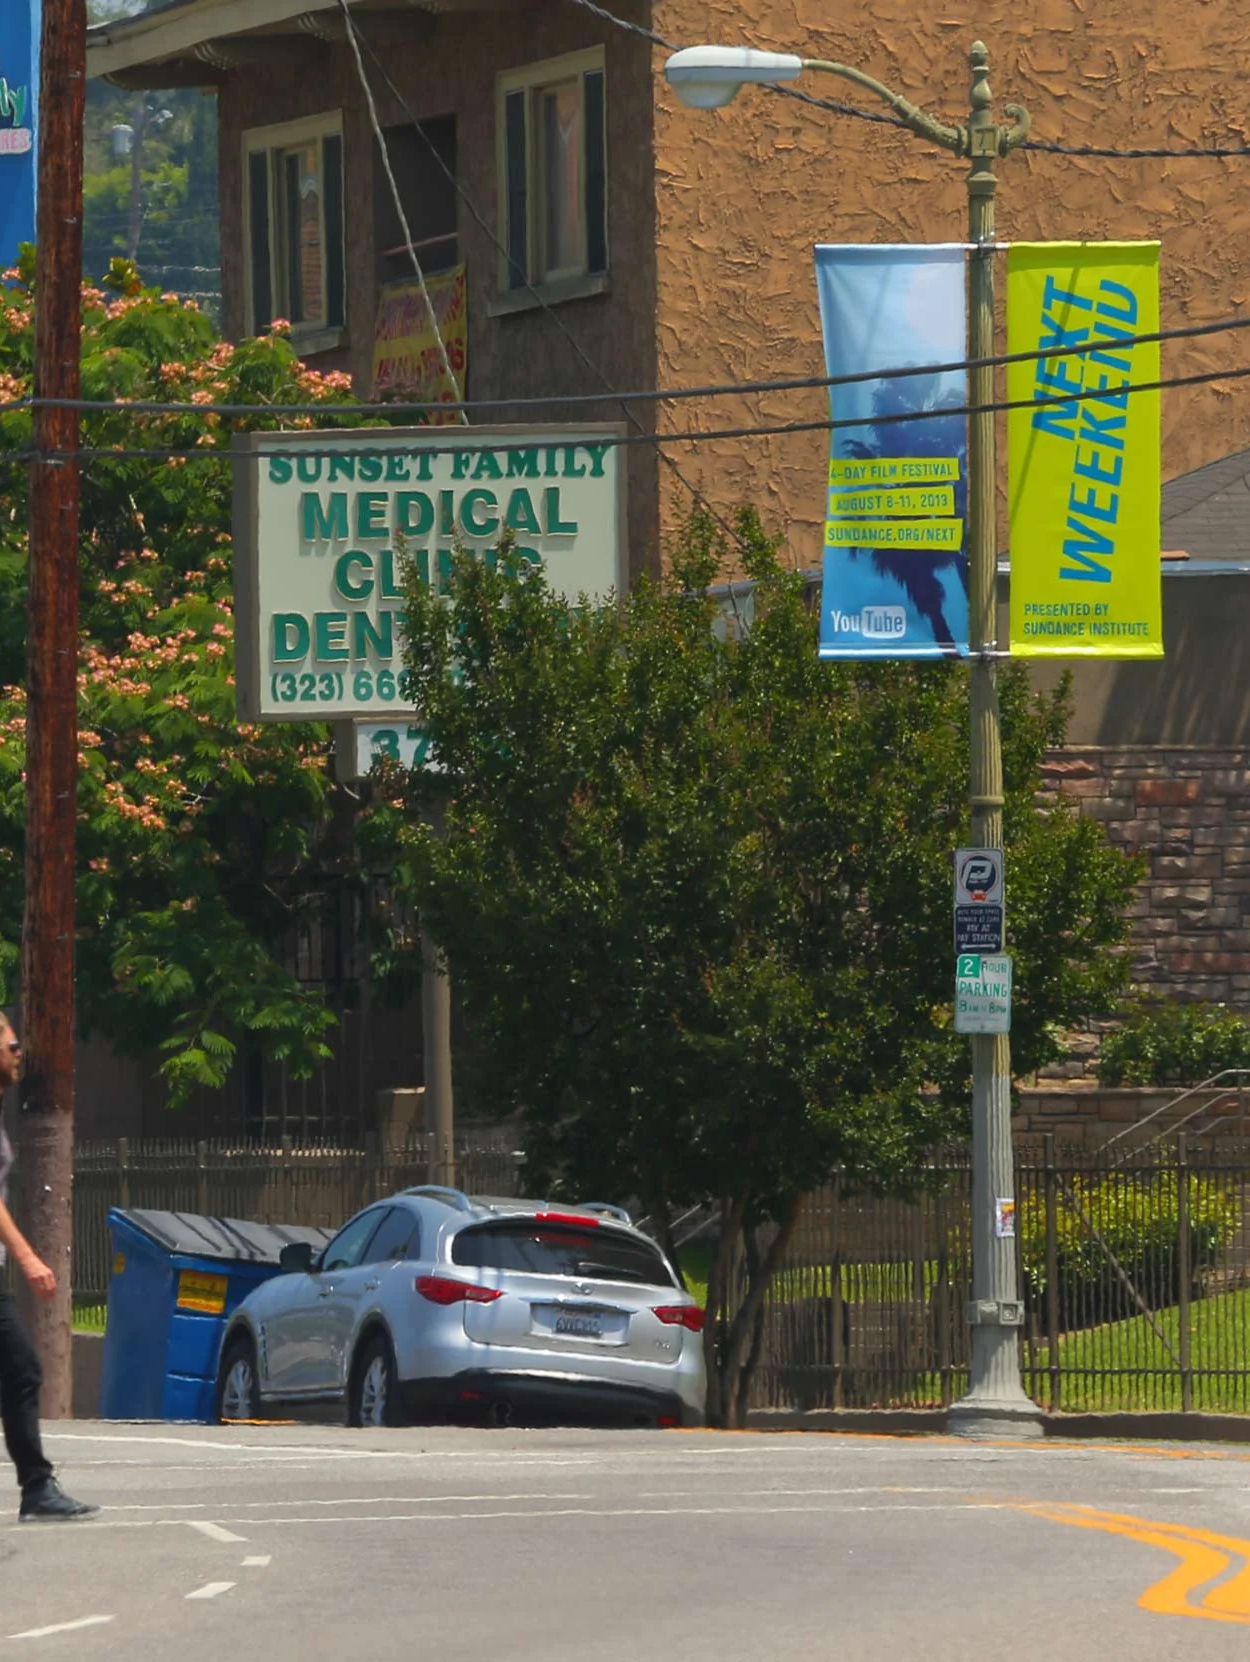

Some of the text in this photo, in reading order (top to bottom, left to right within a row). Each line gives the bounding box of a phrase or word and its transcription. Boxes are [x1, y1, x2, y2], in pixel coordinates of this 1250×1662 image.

[1032, 275, 1094, 441] NEXT
[1059, 279, 1139, 584] WEEKEND
[268, 444, 612, 484] SUNSET FAMILY
[870, 465, 897, 478] FILM
[901, 463, 952, 477] FESTIVAL
[299, 486, 579, 543] MEDICAL
[836, 495, 883, 512] AUGUST
[920, 493, 948, 508] 2013
[827, 527, 956, 542] SUNDANCE.ORG/NEXT
[830, 605, 906, 639] YouTube
[1024, 602, 1109, 617] PRESENTED BY
[272, 610, 407, 665] DEN
[1023, 621, 1150, 636] SUNDANCE INSTITUTE
[271, 671, 344, 703] (323)
[963, 958, 974, 976] 2
[958, 981, 1008, 998] PARKING
